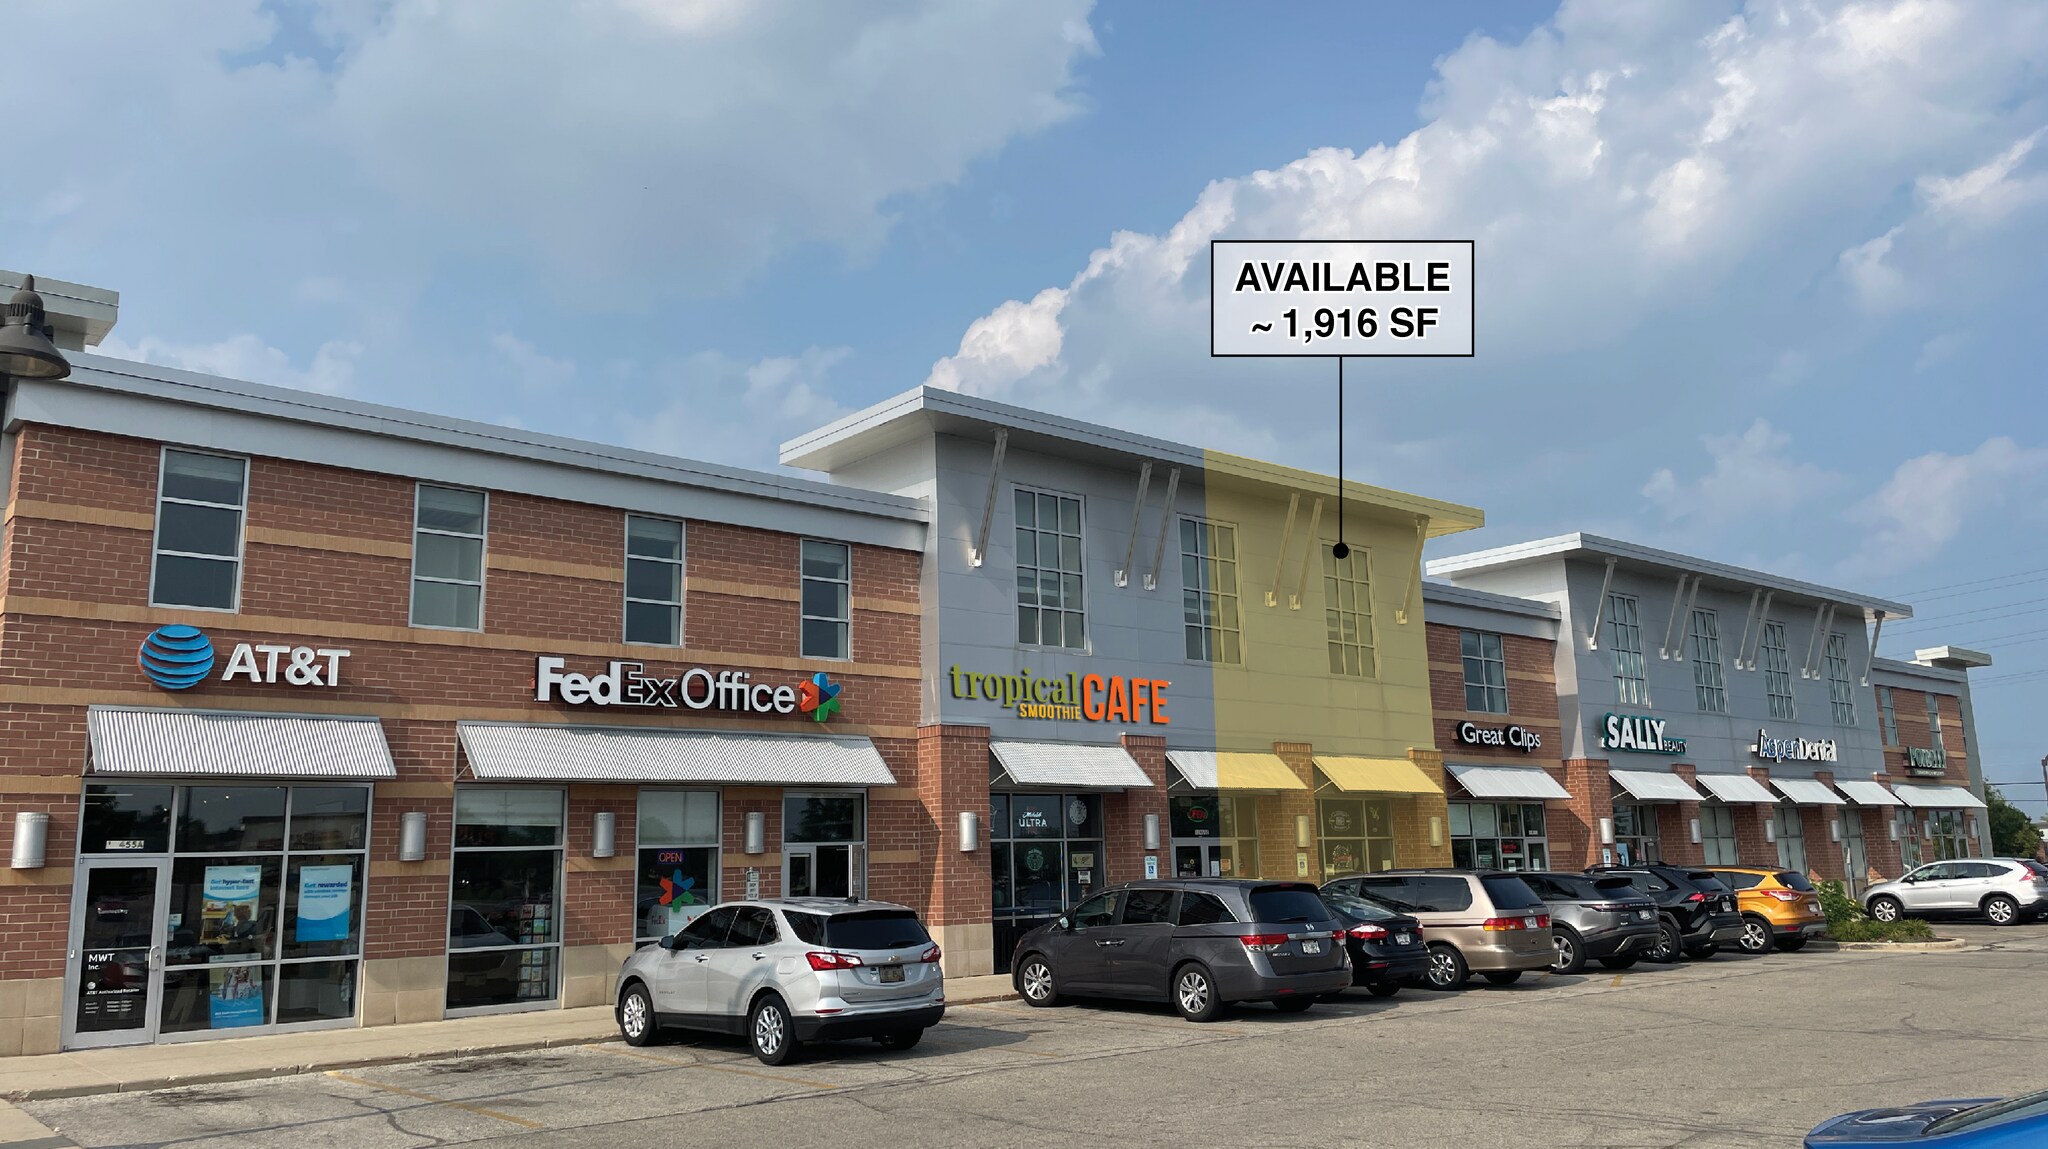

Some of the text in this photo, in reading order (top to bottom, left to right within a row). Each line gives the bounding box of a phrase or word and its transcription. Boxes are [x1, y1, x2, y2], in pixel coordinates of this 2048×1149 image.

[221, 643, 351, 687] AT&T
[536, 656, 796, 714] FedEx Office
[950, 662, 1081, 708] tropical
[1082, 673, 1171, 724] CAFE
[1018, 703, 1082, 721] SMOOTHIE
[1461, 721, 1542, 751] Great Clips
[1606, 714, 1667, 751] SALLY
[1663, 737, 1688, 752] BEAUTY
[1018, 818, 1048, 828] ULTRA
[659, 852, 683, 863] OPEN
[88, 953, 115, 963] MWT
